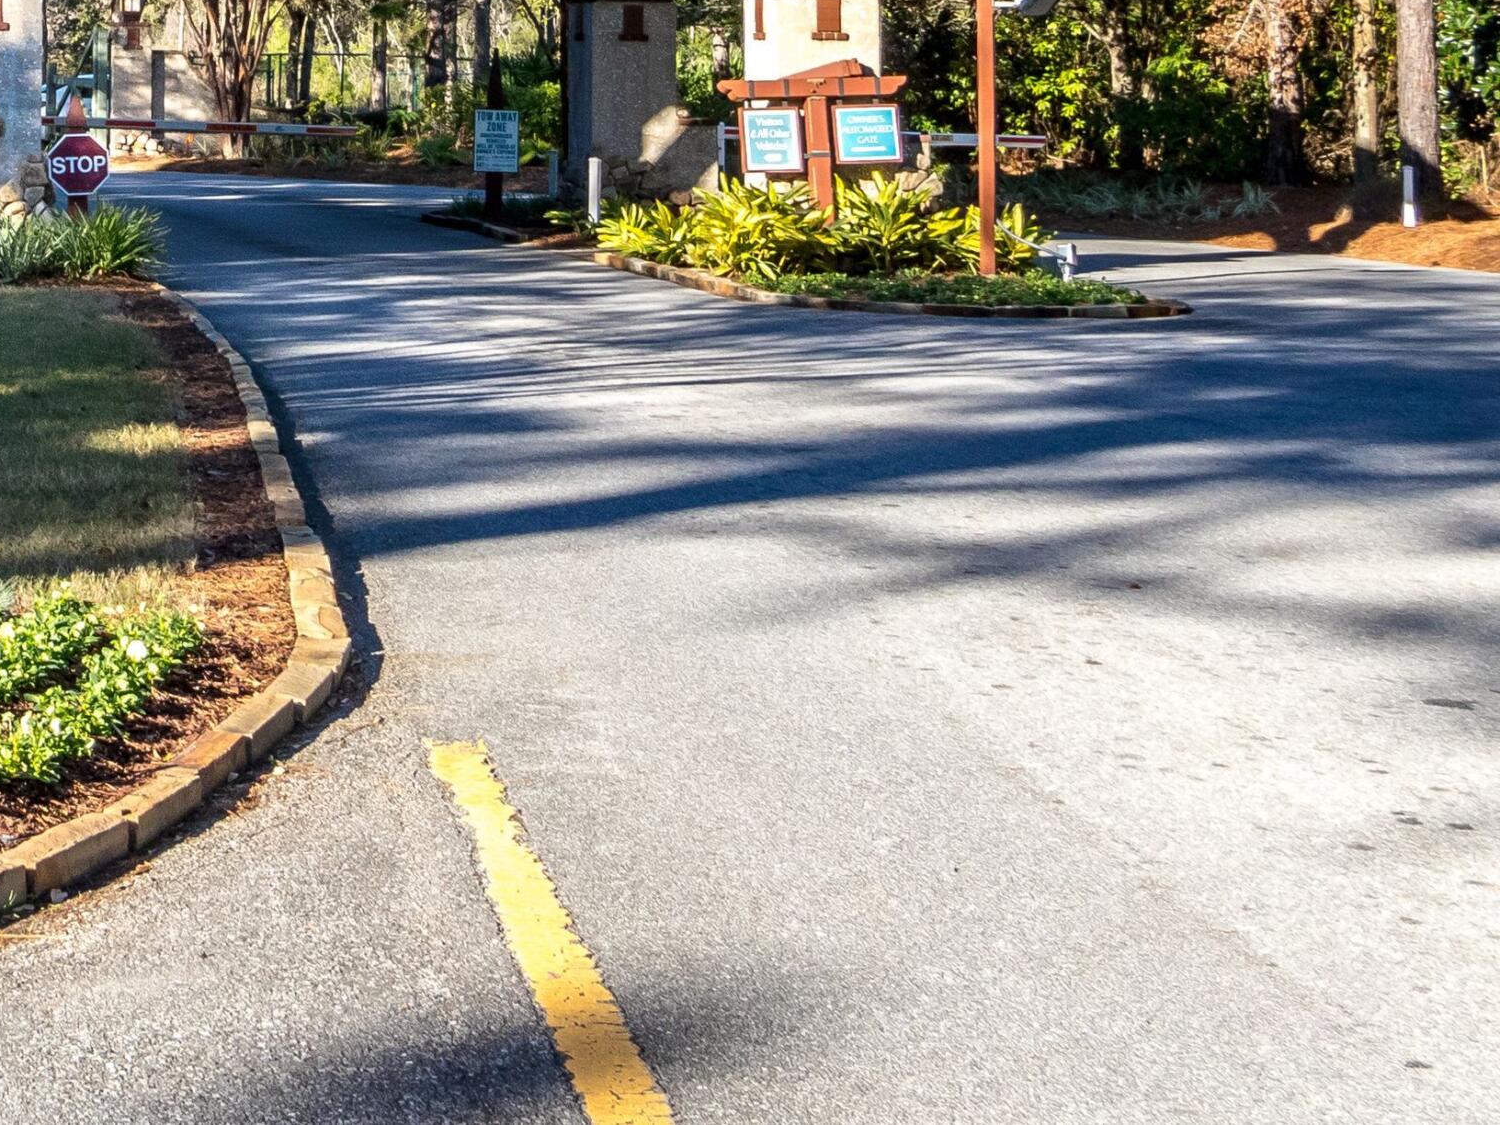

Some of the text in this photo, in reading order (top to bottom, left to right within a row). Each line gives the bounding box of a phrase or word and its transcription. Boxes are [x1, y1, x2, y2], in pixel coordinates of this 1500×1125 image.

[478, 112, 517, 122] TOW AWAY
[755, 115, 784, 127] Visitors
[486, 122, 507, 132] ZONE
[842, 124, 893, 134] AUTOMATED
[757, 128, 769, 138] All
[769, 128, 790, 138] Other
[856, 135, 879, 144] GATE
[755, 140, 788, 151] Vehicles
[52, 155, 106, 174] STOP
